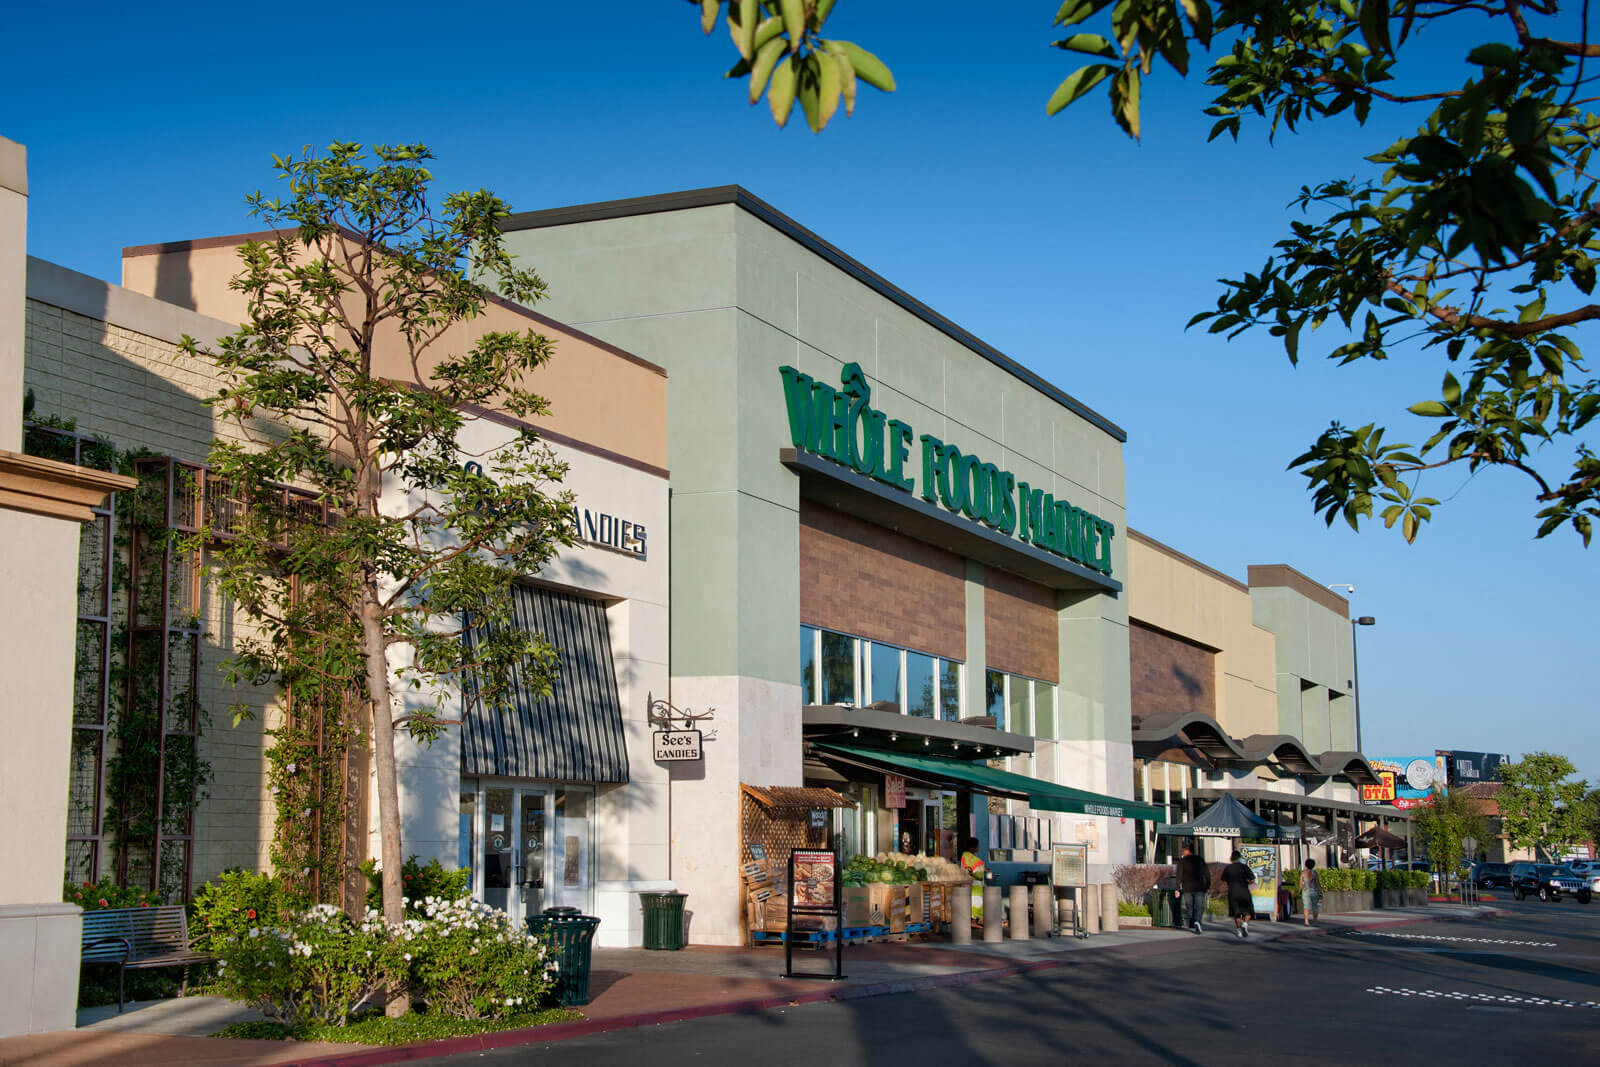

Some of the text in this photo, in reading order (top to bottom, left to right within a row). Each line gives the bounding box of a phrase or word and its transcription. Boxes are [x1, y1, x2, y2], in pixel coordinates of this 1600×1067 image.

[779, 362, 1115, 577] WHOLE FOODS MARKET
[572, 505, 647, 555] ANDIES
[662, 734, 692, 746] See's
[657, 749, 698, 758] CANDIES
[1084, 804, 1123, 817] WHOLE FOODS MARKET
[1193, 826, 1241, 834] WHOLE FOODS
